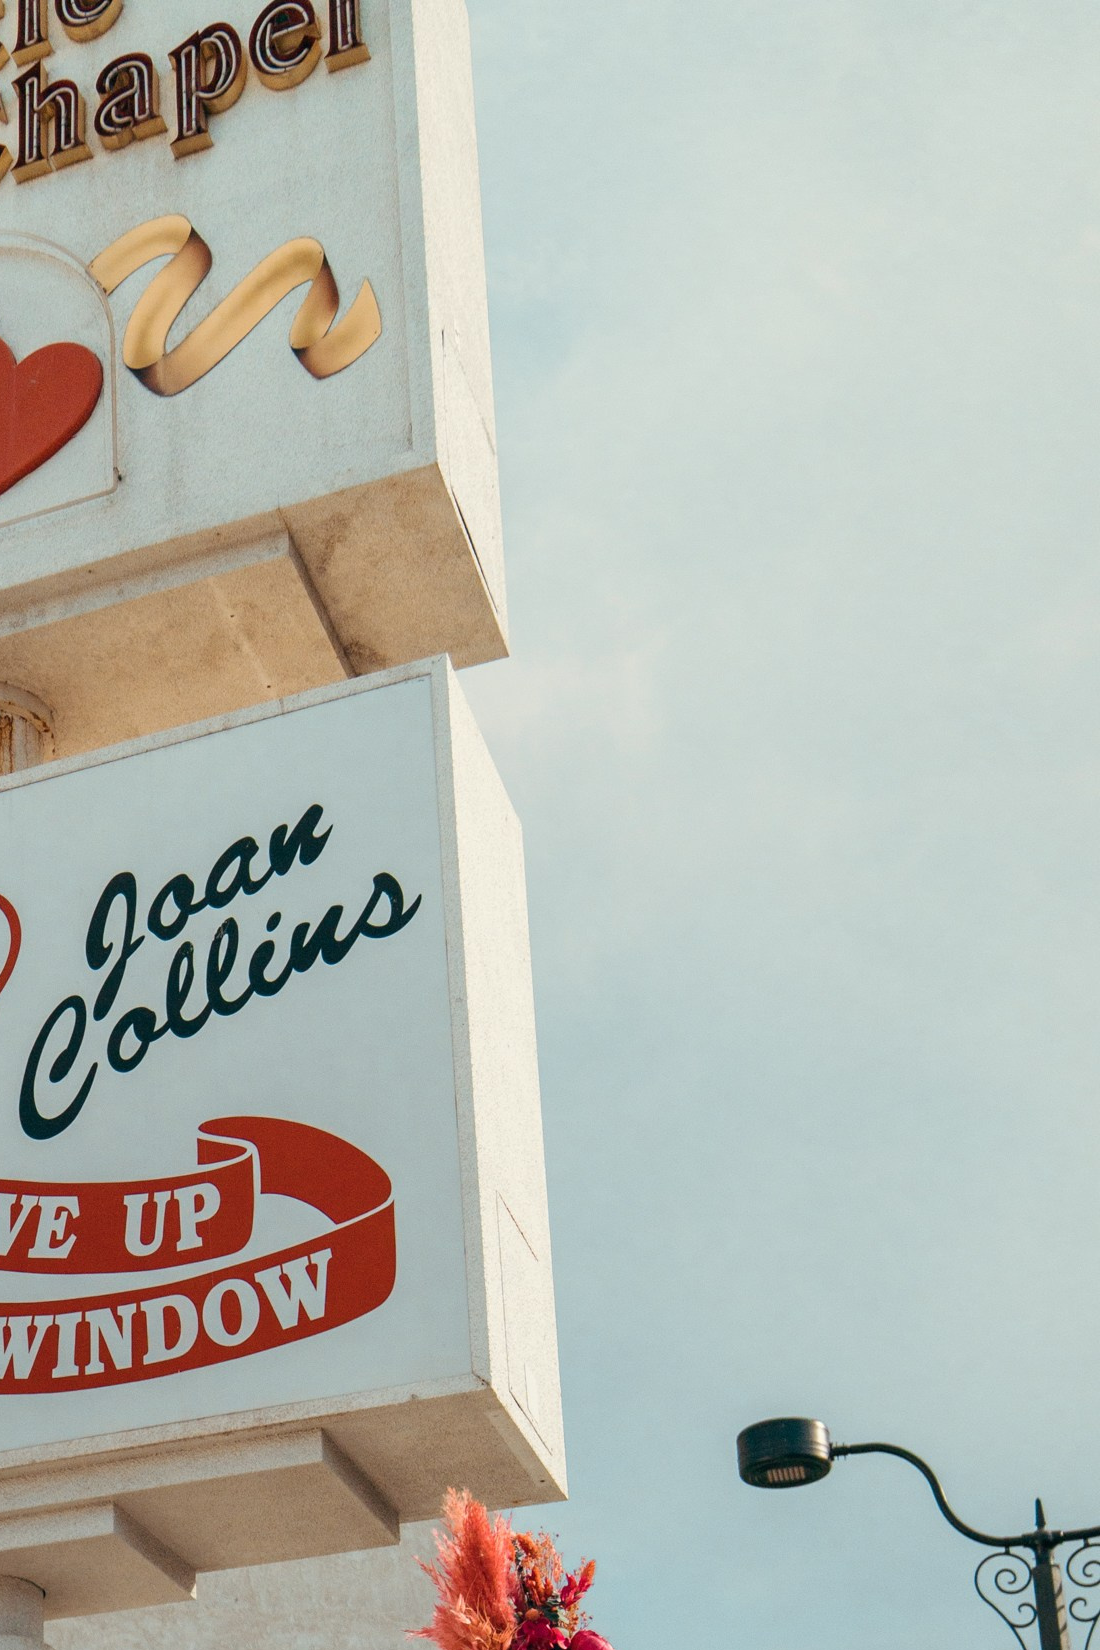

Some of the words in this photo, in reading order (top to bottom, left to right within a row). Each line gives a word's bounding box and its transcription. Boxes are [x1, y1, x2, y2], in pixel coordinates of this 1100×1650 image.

[19, 872, 422, 1140] Collins
[85, 804, 333, 1021] Joan
[122, 1183, 222, 1257] UP
